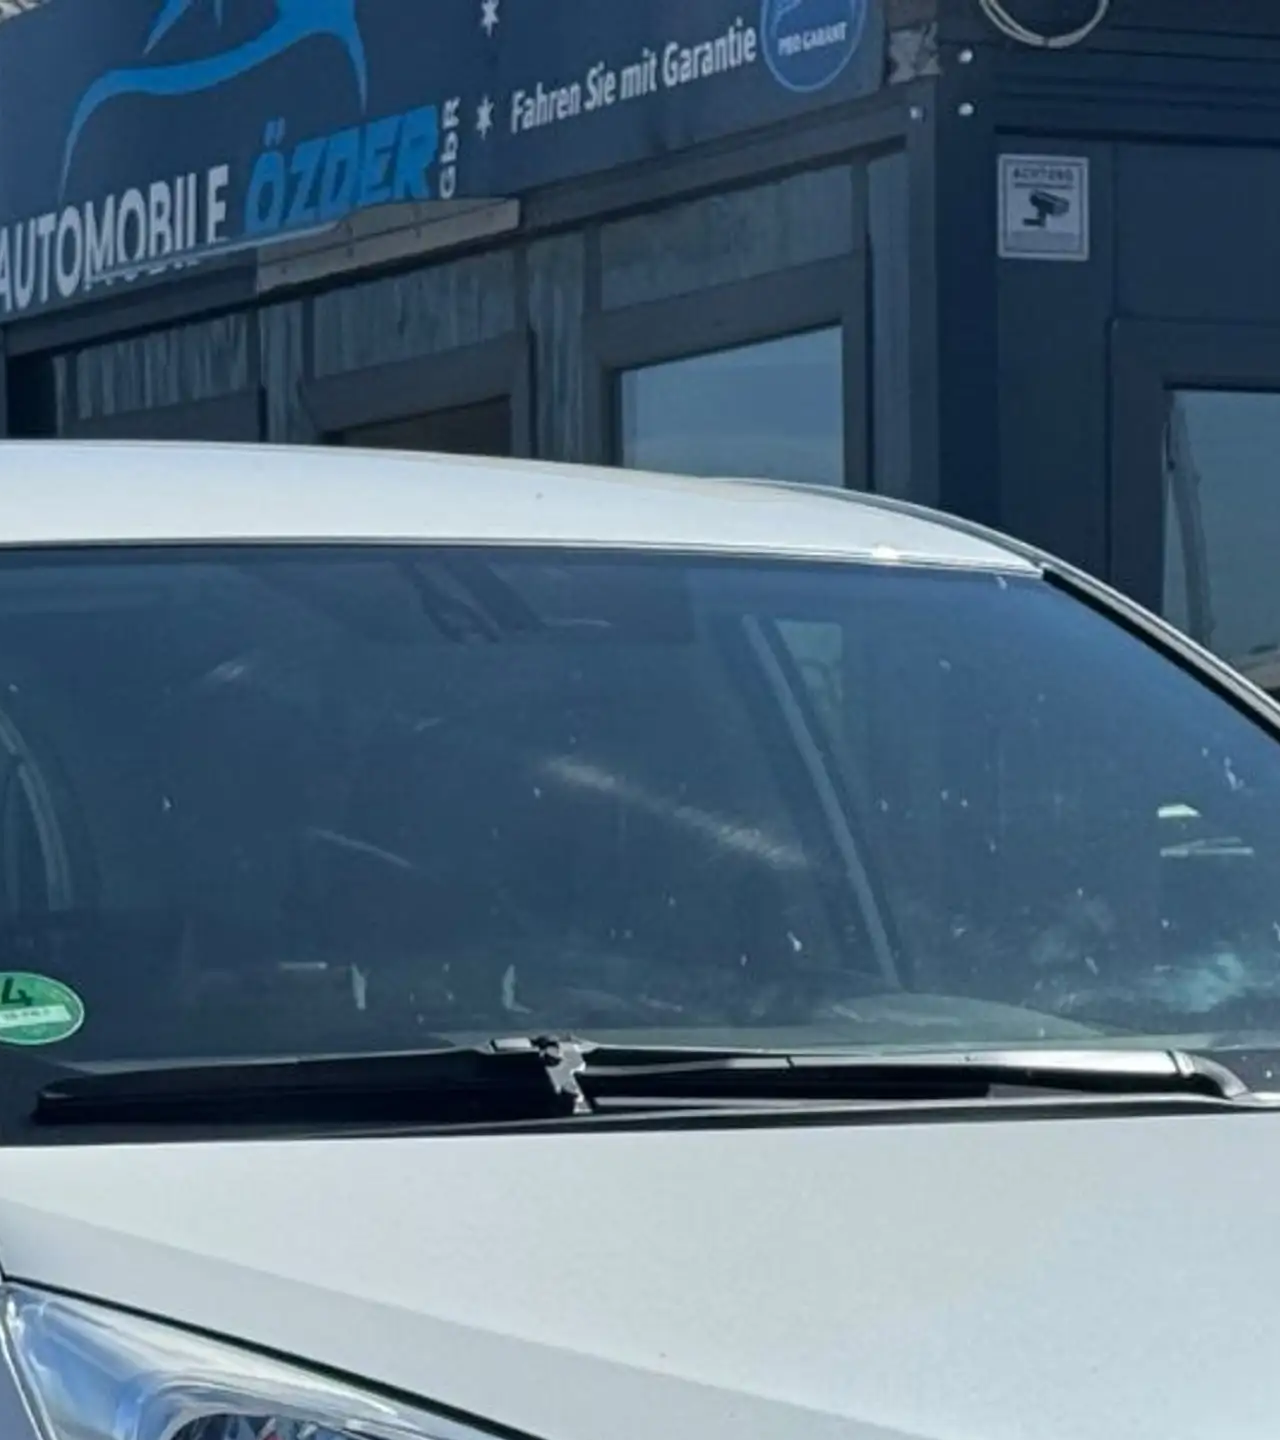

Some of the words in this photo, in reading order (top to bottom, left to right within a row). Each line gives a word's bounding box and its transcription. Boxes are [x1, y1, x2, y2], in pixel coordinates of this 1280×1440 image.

[510, 82, 581, 134] Fahren
[584, 61, 617, 111] Sie
[620, 47, 658, 100] mit
[662, 16, 757, 87] Garantie
[243, 104, 440, 234] ÖZDER
[1, 976, 33, 1007] 4
